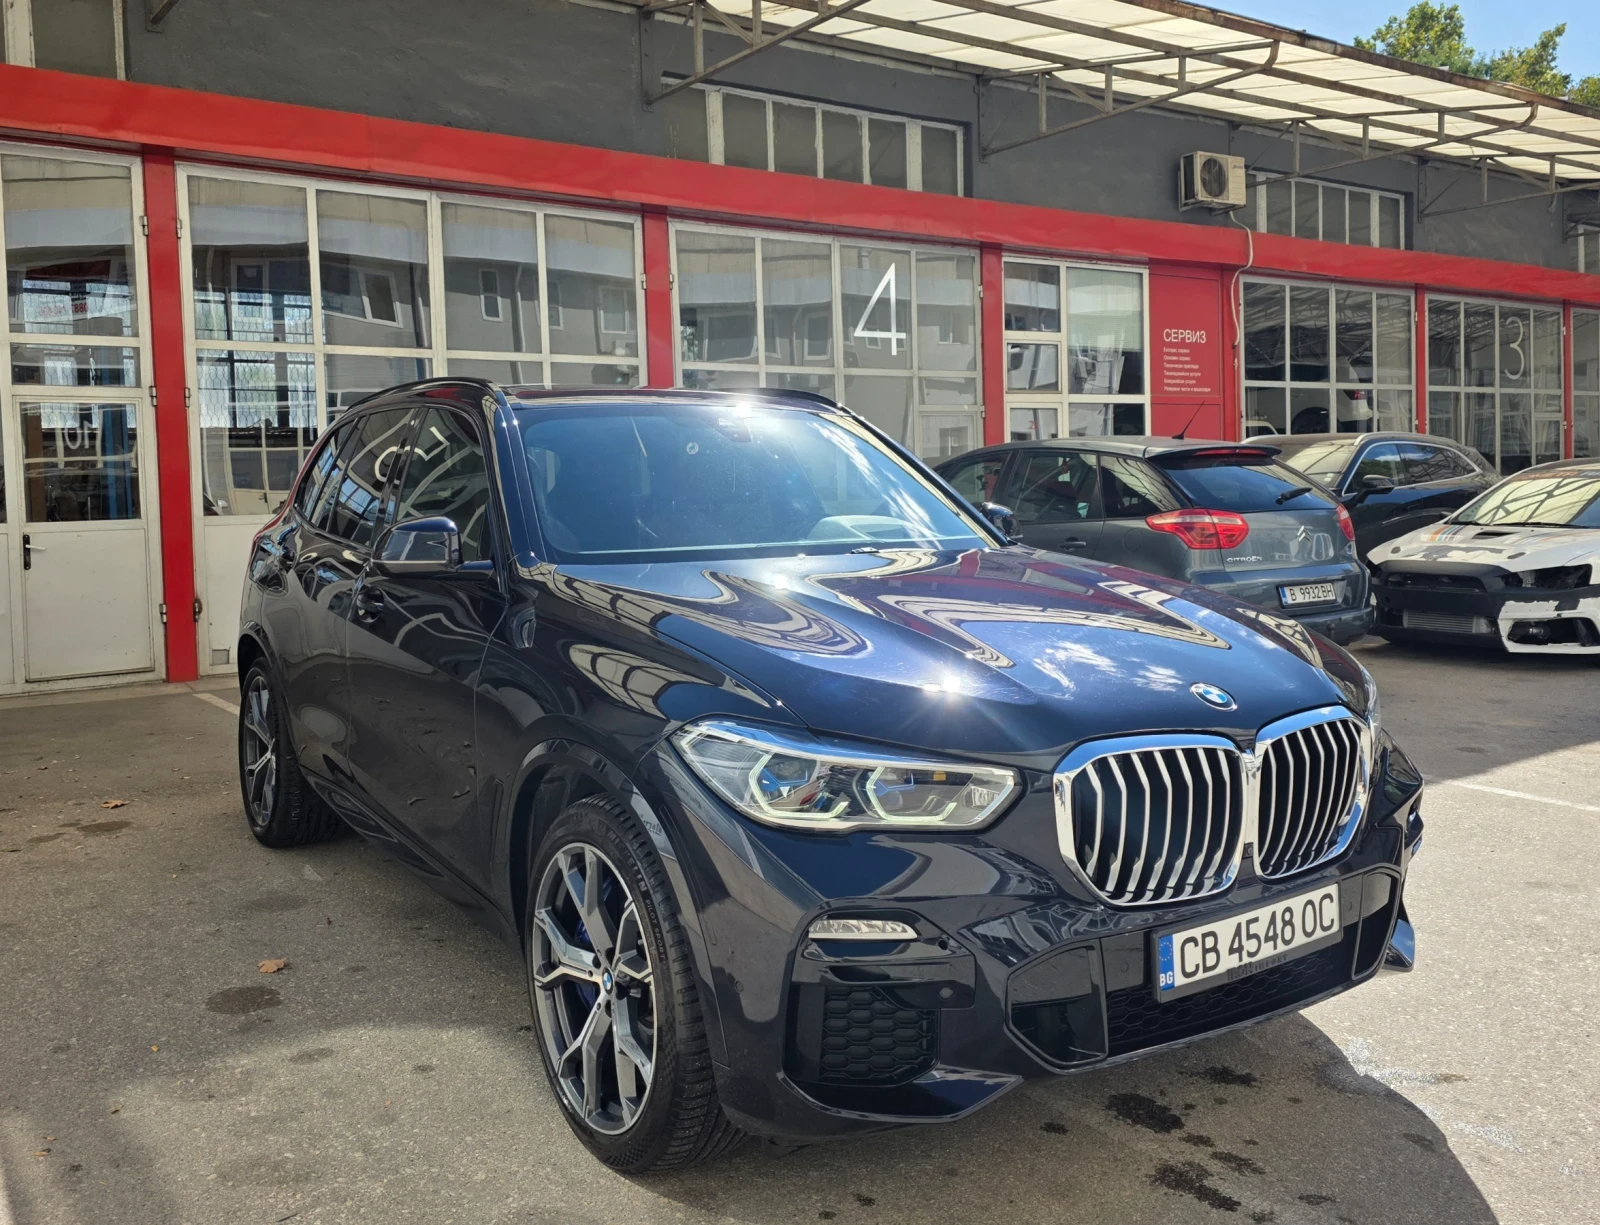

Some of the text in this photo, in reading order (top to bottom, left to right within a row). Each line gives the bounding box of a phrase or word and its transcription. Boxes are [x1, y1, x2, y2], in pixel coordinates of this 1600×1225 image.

[853, 262, 907, 356] 4
[1163, 328, 1207, 343] СЕРВИЗ
[1504, 316, 1525, 380] 3
[644, 899, 659, 925] PILOT
[654, 928, 667, 962] SPORT
[1180, 892, 1335, 979] CB 4548 OC
[1159, 970, 1174, 987] BG
